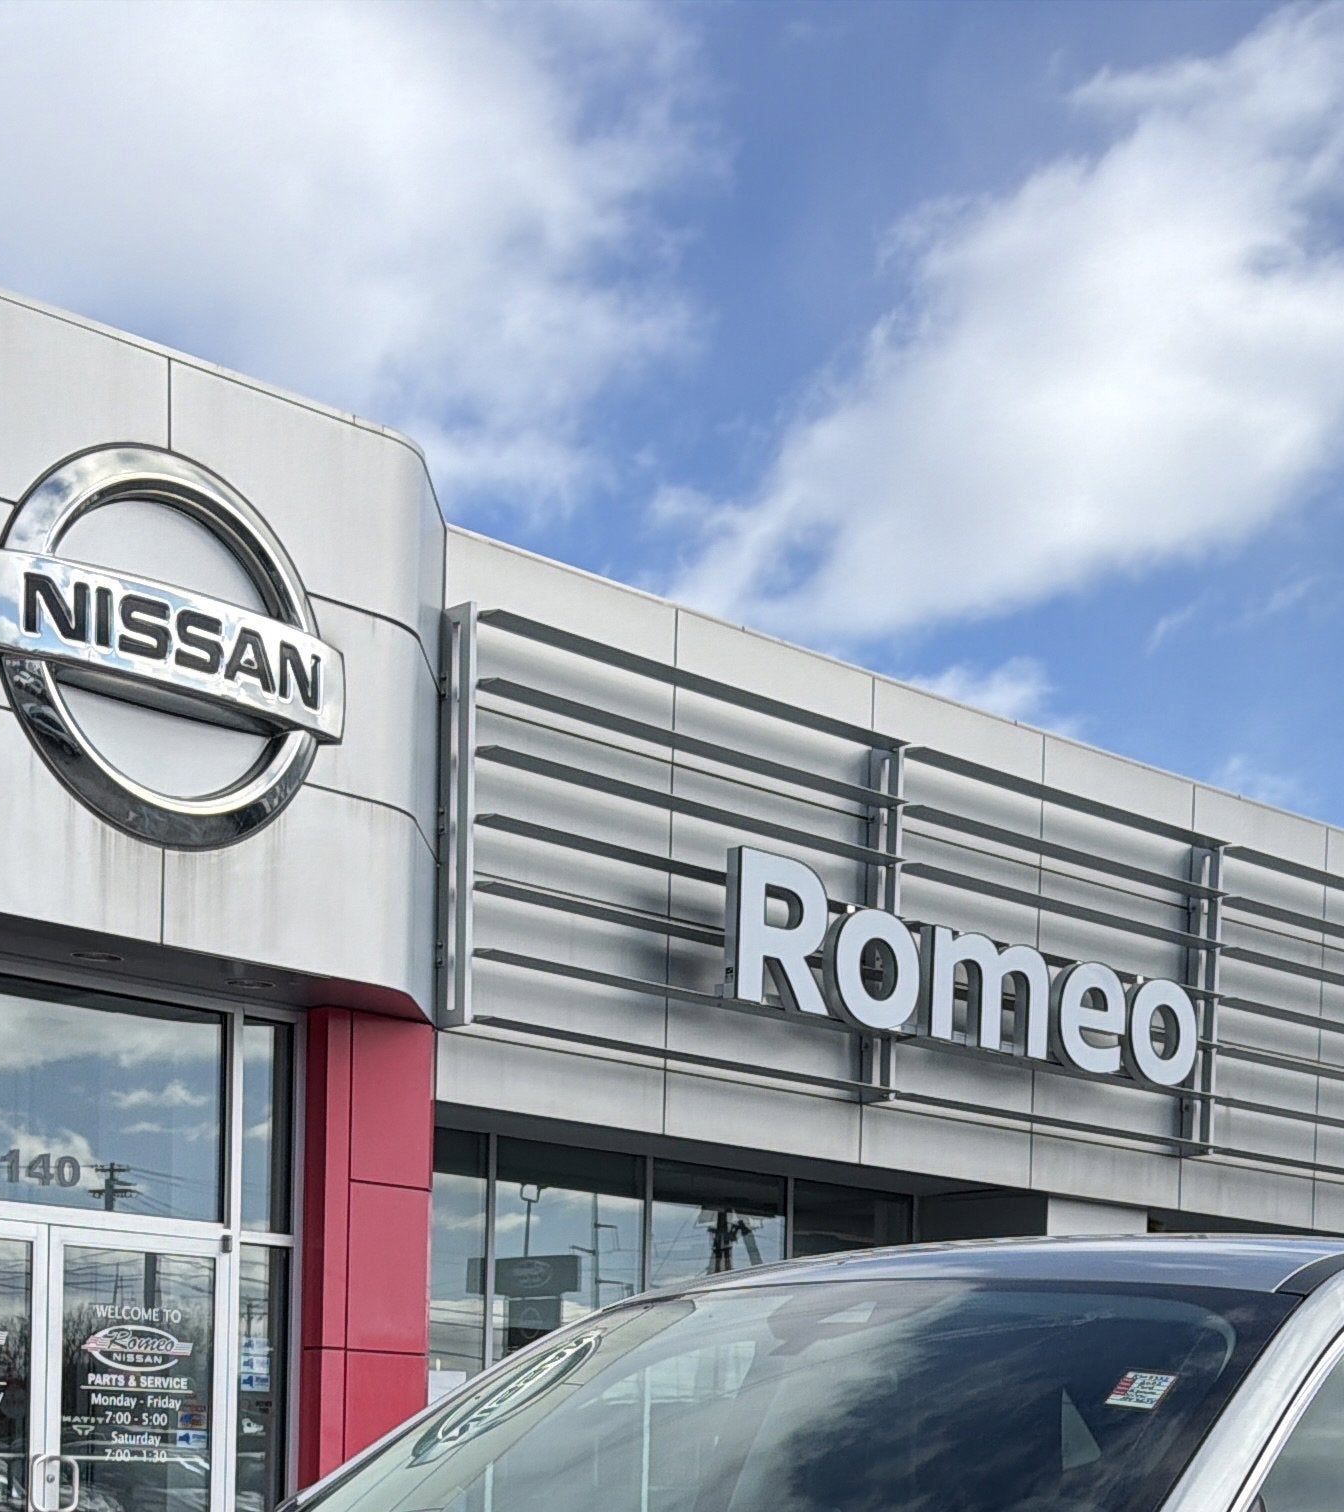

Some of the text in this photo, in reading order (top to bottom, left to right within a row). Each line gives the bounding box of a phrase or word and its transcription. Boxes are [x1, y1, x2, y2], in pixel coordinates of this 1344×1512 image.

[24, 572, 322, 710] NISSAN
[726, 845, 1197, 1086] Romeo
[0, 1149, 81, 1187] 140
[96, 1304, 182, 1324] WELCOME TO
[107, 1328, 175, 1352] Romeo
[113, 1353, 163, 1364] NISSAN
[88, 1373, 188, 1389] PARTS & SERVICE
[90, 1393, 137, 1411] Monday
[147, 1395, 182, 1411] Friday
[105, 1411, 131, 1425] 7:00
[142, 1413, 168, 1426] 5:00
[111, 1430, 162, 1447] Saturday
[105, 1449, 131, 1462] 7:00
